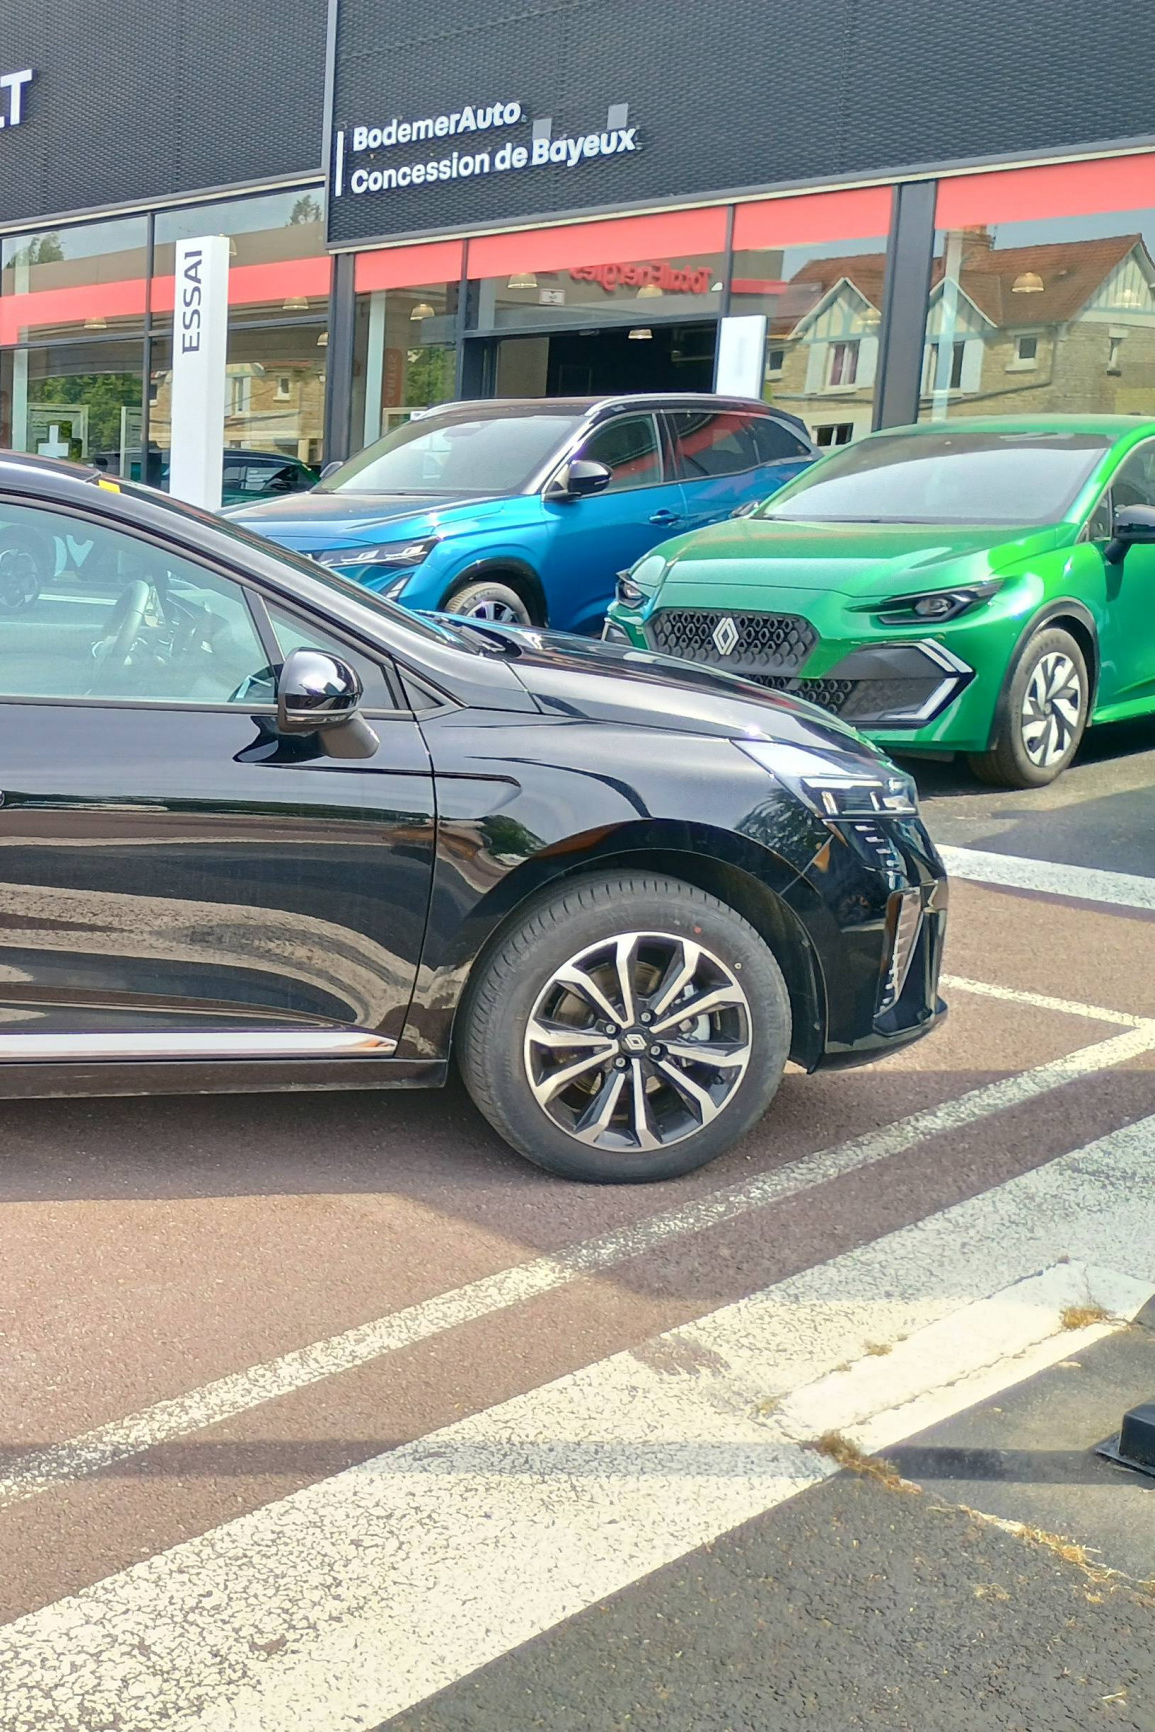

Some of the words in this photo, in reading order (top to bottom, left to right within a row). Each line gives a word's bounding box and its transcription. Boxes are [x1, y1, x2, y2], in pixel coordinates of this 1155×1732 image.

[352, 101, 522, 151] BodemerAuto
[350, 151, 490, 194] Concession
[495, 142, 528, 171] de
[531, 128, 636, 167] Bayeux
[182, 249, 202, 355] ESSAI
